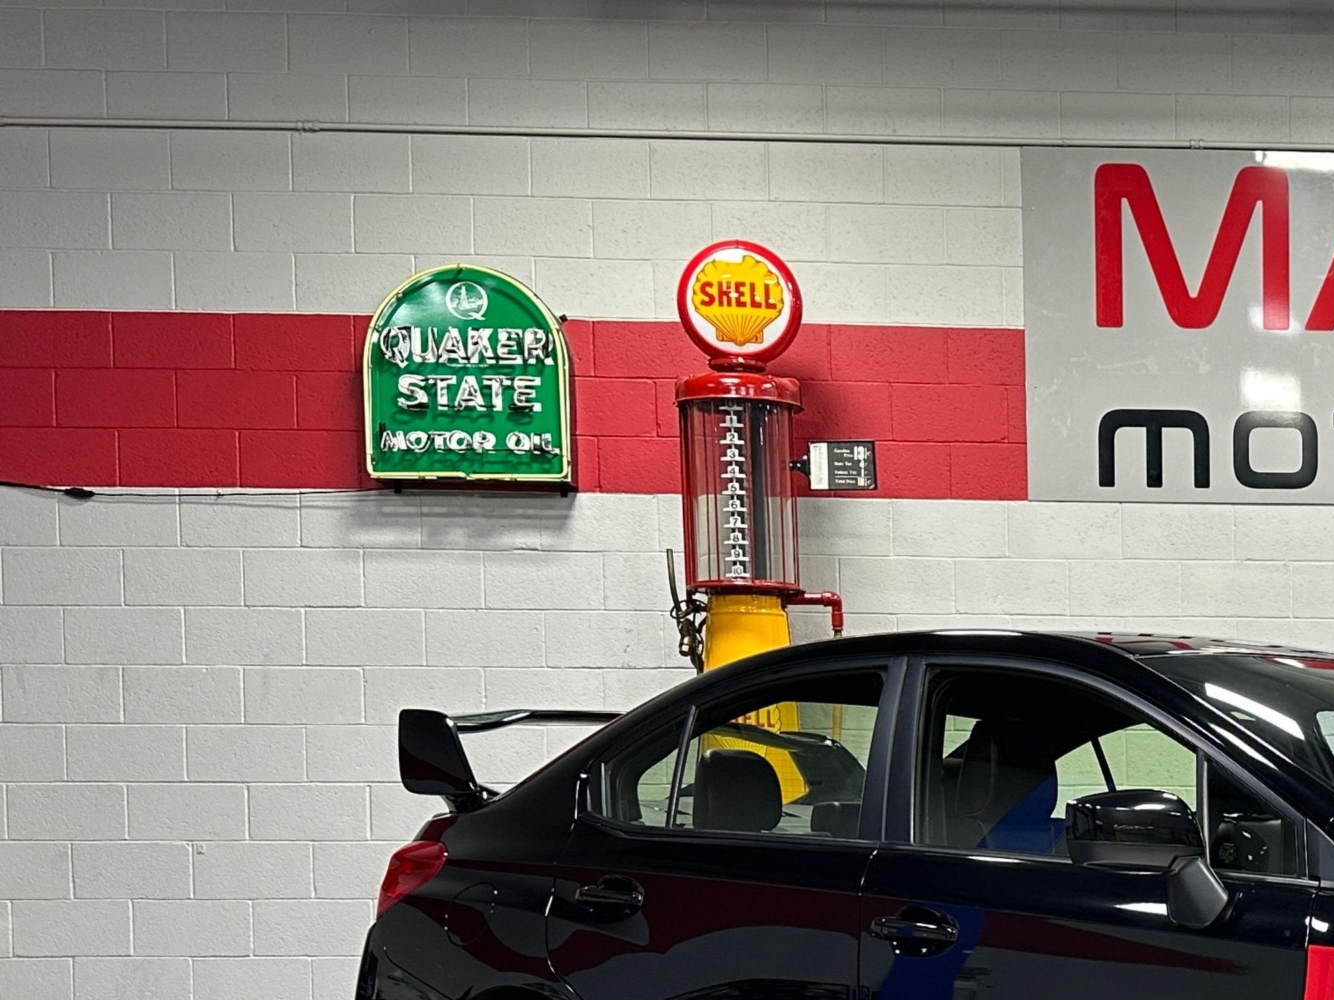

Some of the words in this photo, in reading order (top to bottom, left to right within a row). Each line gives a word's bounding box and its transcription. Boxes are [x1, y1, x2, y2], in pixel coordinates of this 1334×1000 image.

[699, 281, 778, 310] SHELL
[380, 325, 555, 368] QUAKER
[397, 373, 542, 412] STATE
[381, 430, 496, 453] MOTOR
[506, 431, 560, 455] OIL
